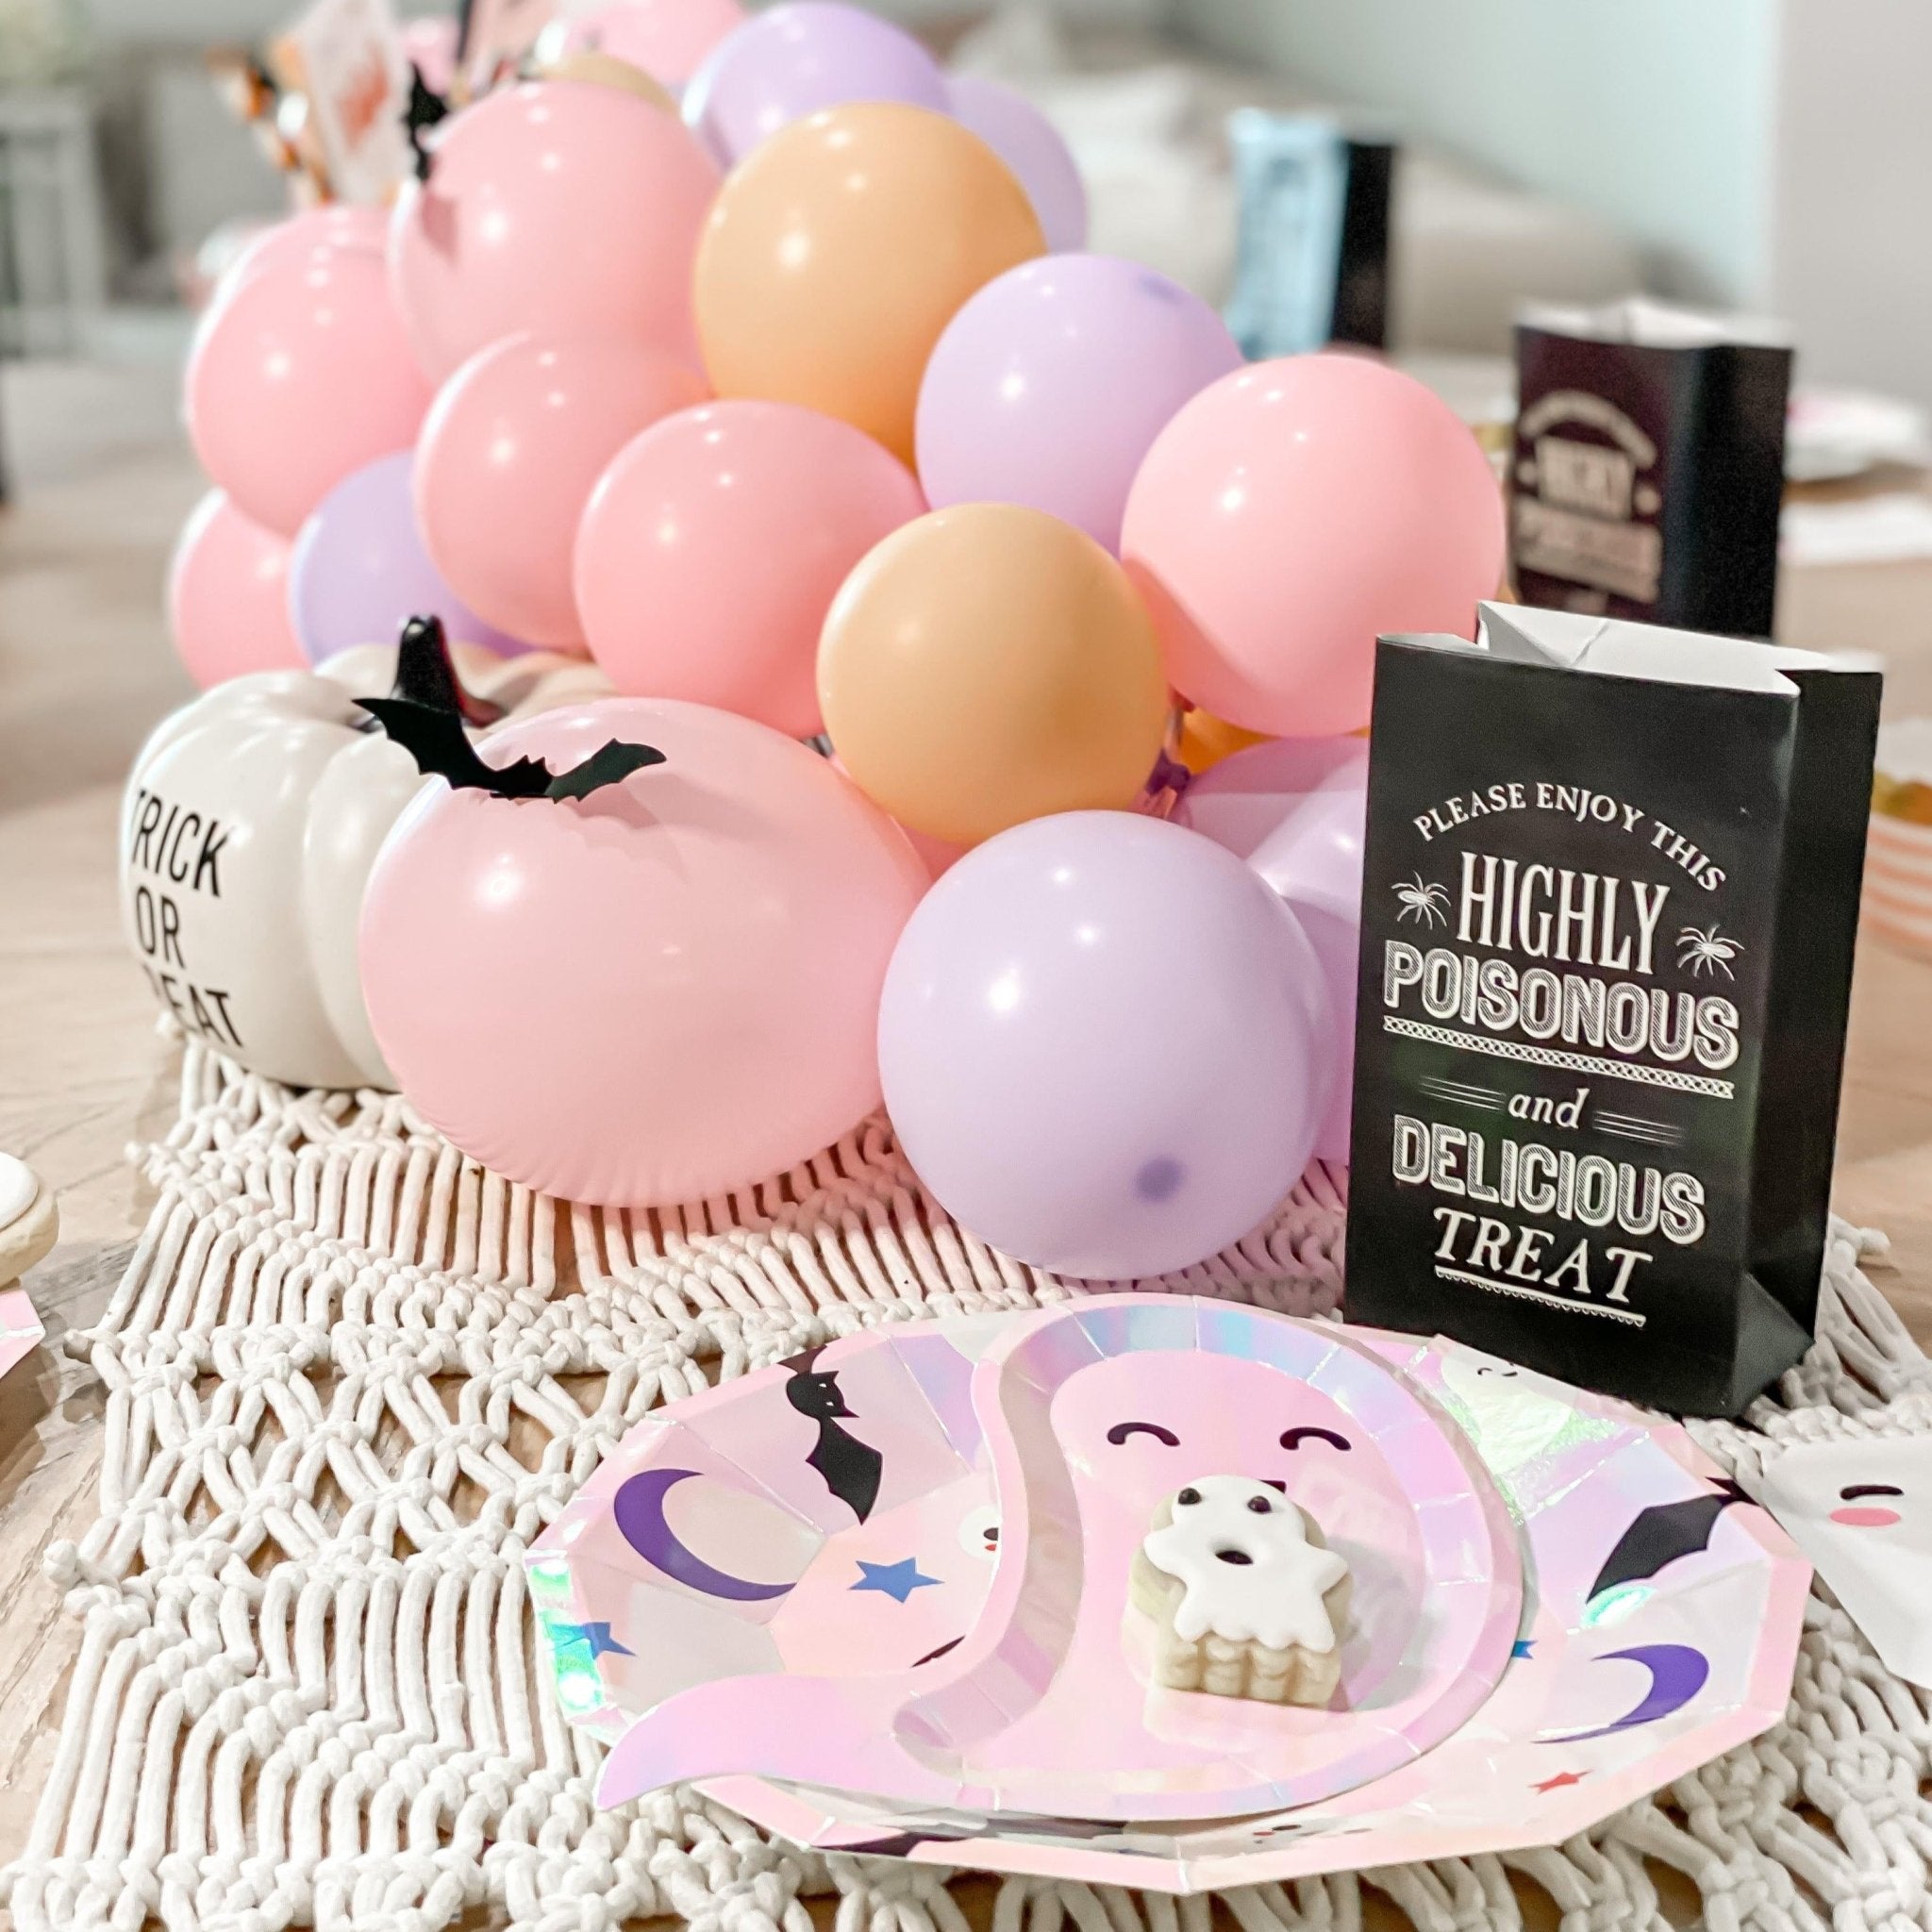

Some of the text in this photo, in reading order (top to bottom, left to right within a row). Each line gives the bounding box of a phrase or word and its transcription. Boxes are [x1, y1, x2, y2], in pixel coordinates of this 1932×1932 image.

[1413, 782, 1727, 892] PLEASE ENJOY THIS
[136, 885, 185, 970] OR
[1457, 851, 1671, 975] HIGHLY
[1383, 940, 1740, 1071] POISONOUS
[1508, 1087, 1591, 1130] and
[1391, 1114, 1706, 1245] DELICIOUS
[1433, 1207, 1654, 1304] TREAT
